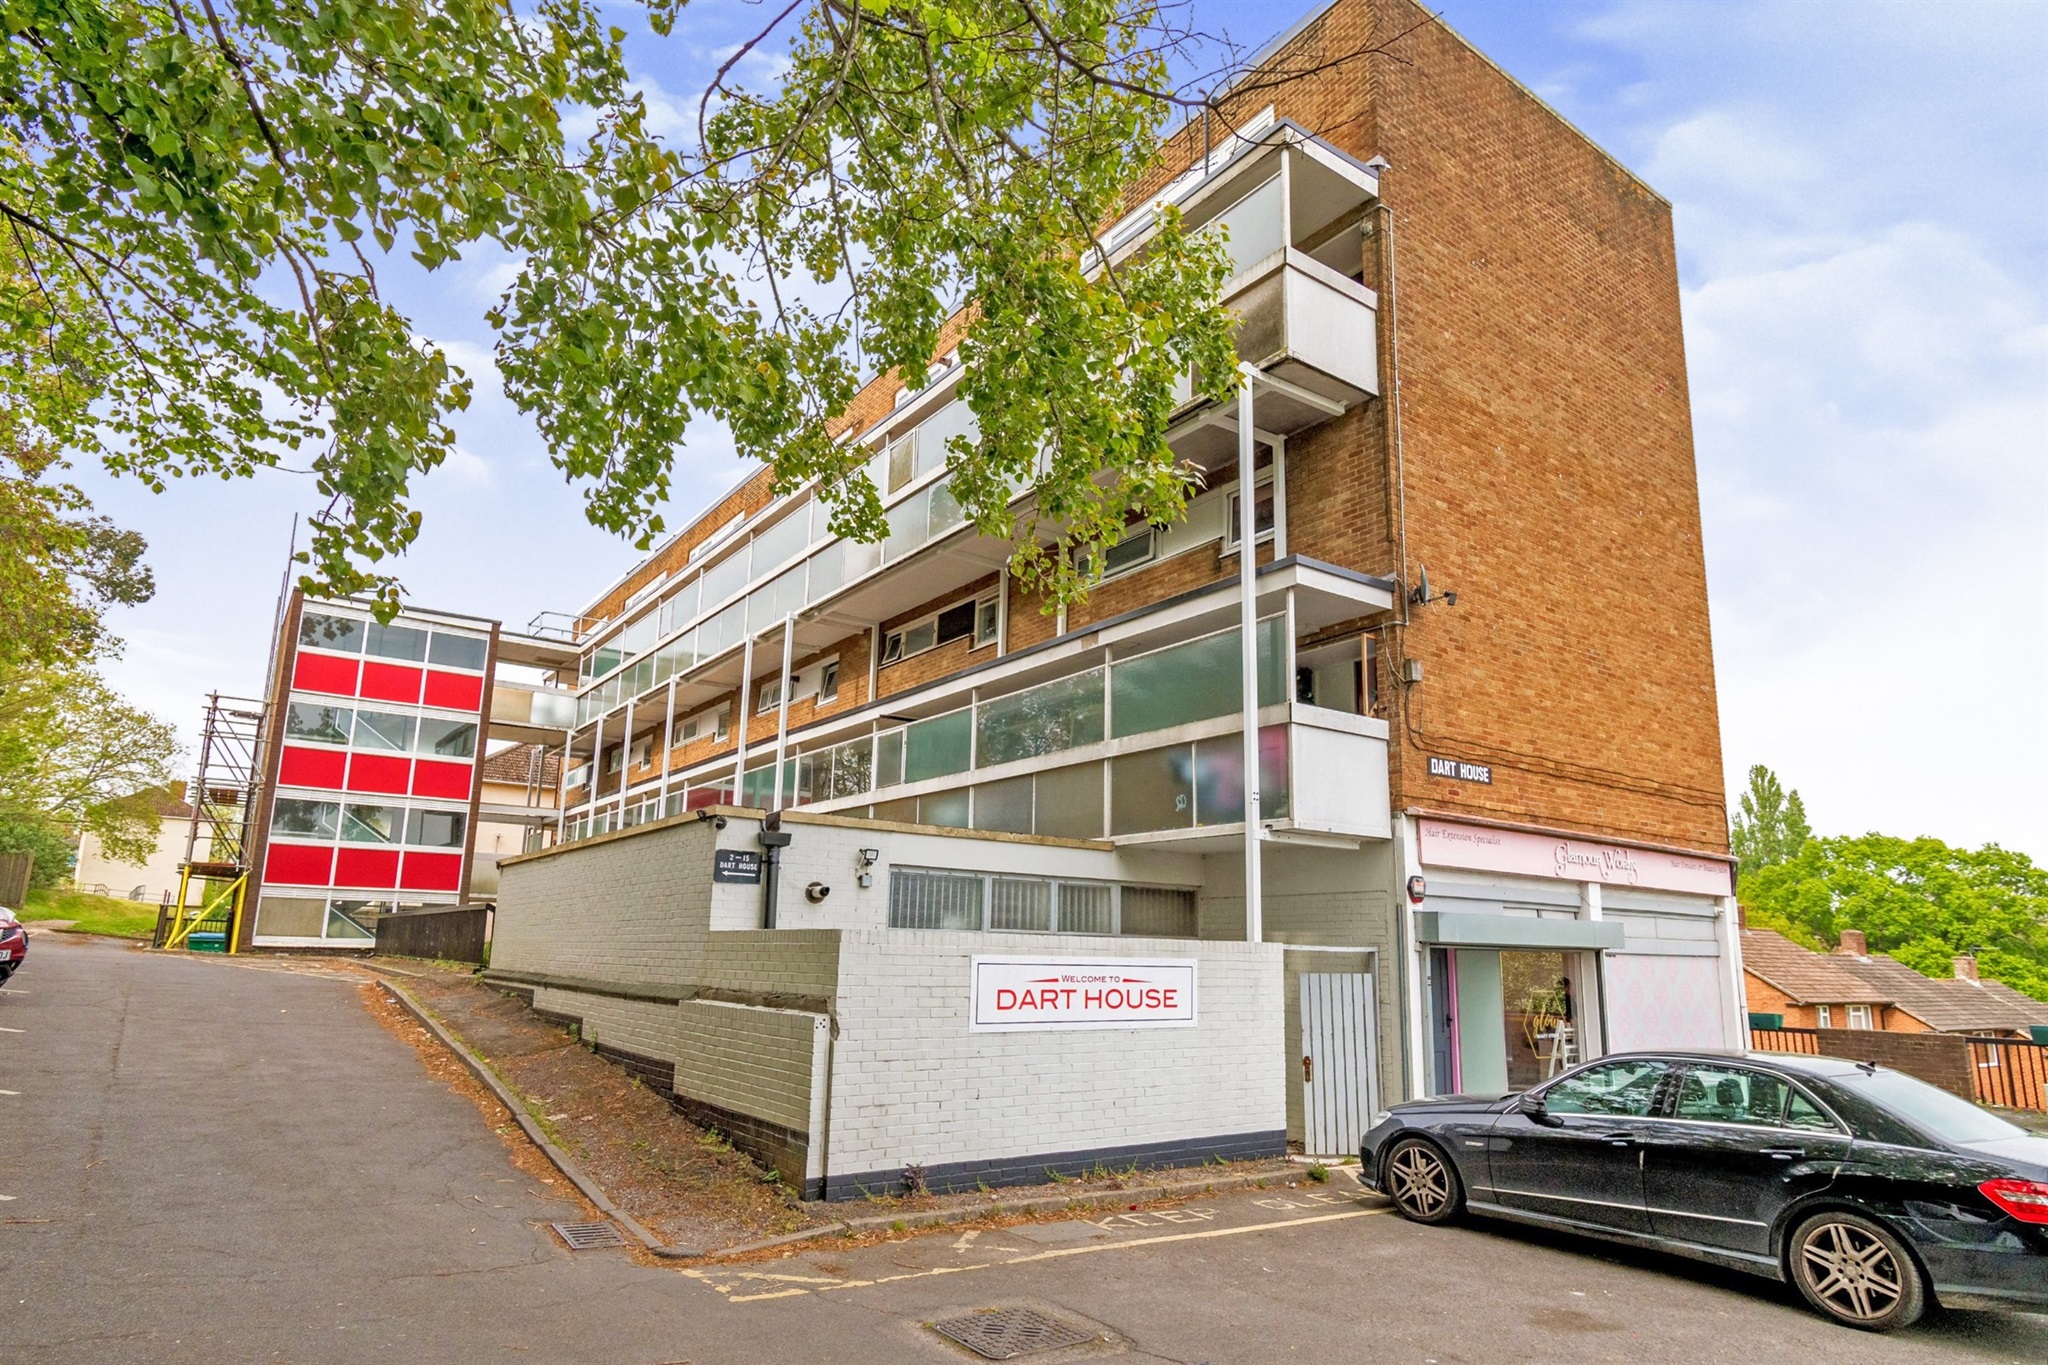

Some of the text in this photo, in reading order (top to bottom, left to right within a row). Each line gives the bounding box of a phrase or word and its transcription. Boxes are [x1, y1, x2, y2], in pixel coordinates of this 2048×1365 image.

[1431, 758, 1490, 783] DART HOUSE
[1425, 827, 1501, 847] Hair Extension Specialist
[720, 861, 758, 871] DART HOUSE
[1061, 975, 1107, 983] WELCOME
[996, 988, 1179, 1011] DART HOUSE
[1081, 1207, 1219, 1231] KEEP
